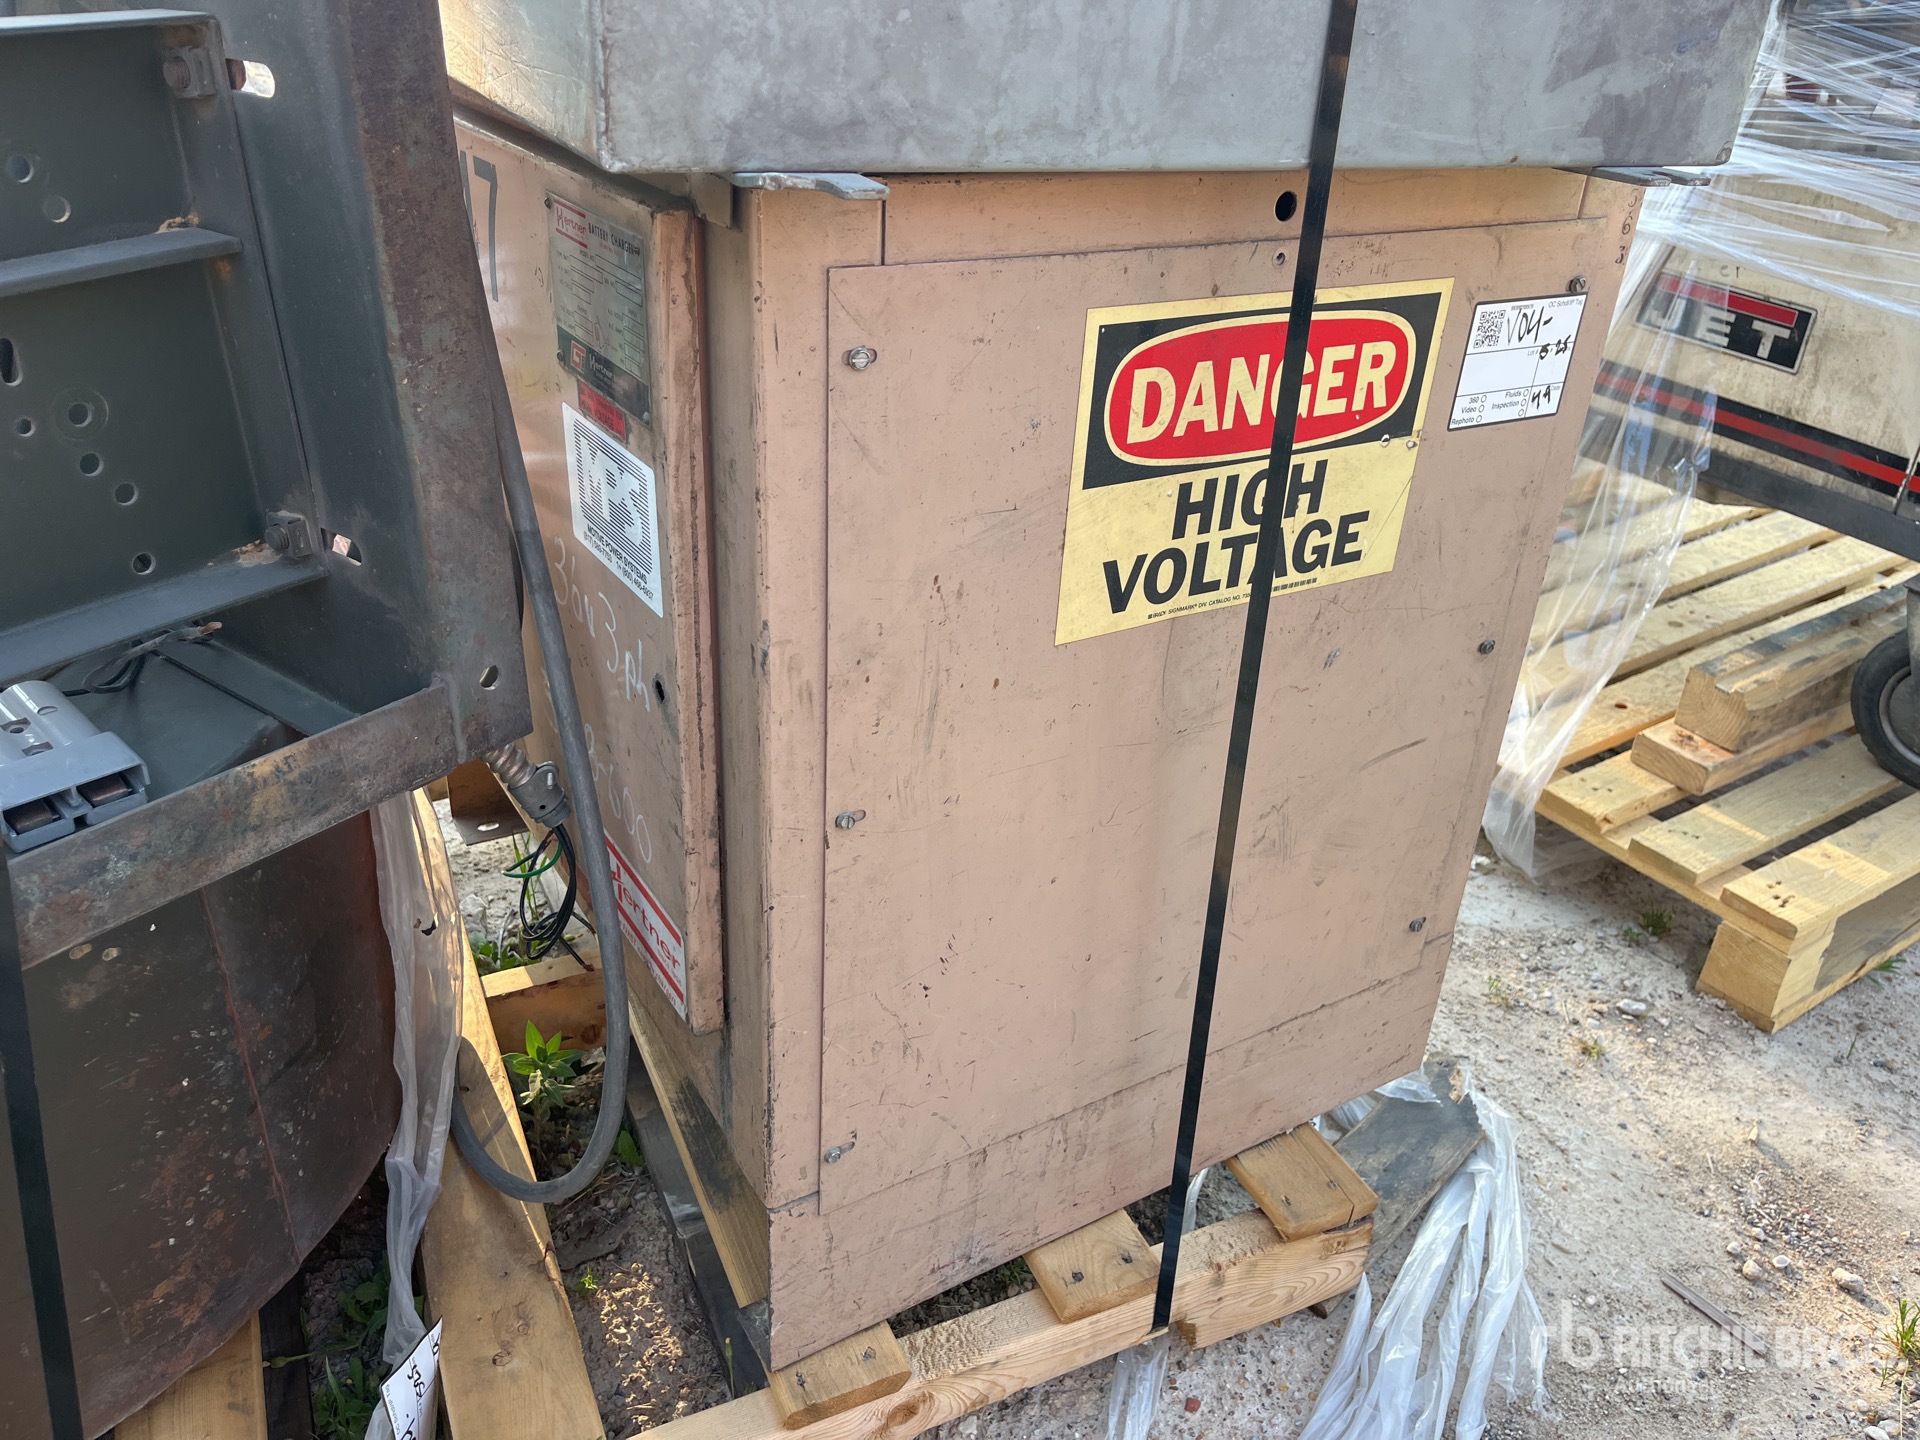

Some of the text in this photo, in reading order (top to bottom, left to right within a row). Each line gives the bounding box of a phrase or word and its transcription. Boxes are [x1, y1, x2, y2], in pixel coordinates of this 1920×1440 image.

[556, 206, 586, 235] Hertner
[588, 222, 608, 242] BATTERY
[610, 233, 634, 256] CHARGER
[1125, 340, 1397, 445] DANGER
[1468, 396, 1479, 404] 360
[1505, 390, 1522, 398] Fluids
[1462, 406, 1477, 414] Video
[1492, 400, 1520, 410] Inspection
[1451, 416, 1474, 426] Rephoto
[1171, 460, 1328, 540] HIGH
[587, 523, 648, 585] MOTIVE POWER SYSTEMS
[1102, 510, 1370, 614] VOLTAGE
[1208, 596, 1232, 606] CATALOG
[1232, 594, 1240, 602] NO.
